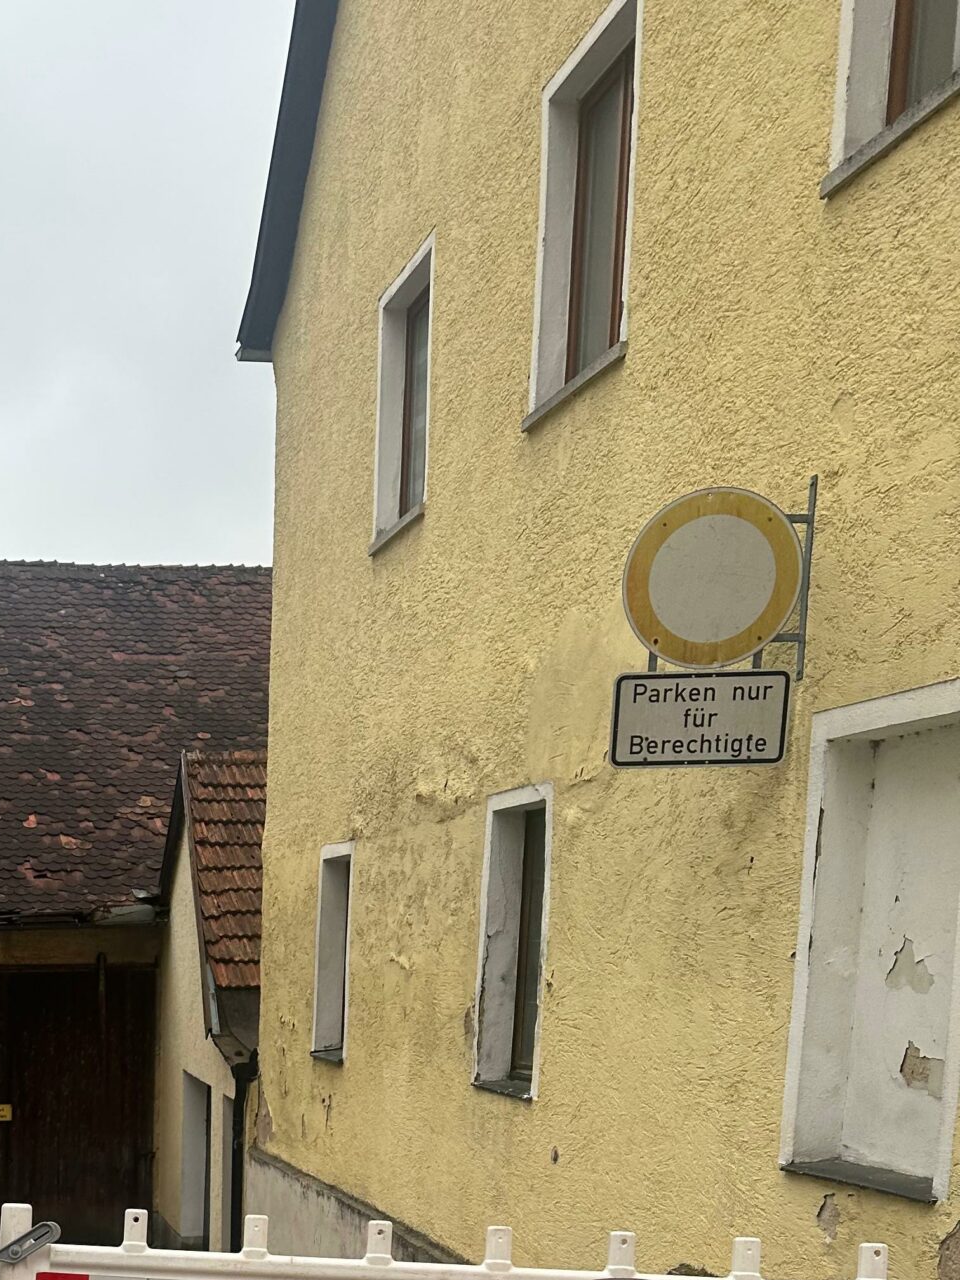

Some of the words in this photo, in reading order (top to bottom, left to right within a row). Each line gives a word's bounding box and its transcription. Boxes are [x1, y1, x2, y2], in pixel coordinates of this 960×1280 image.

[633, 682, 716, 703] Parken
[732, 684, 773, 701] nur
[683, 707, 718, 728] für
[629, 733, 767, 758] Berechtigte
